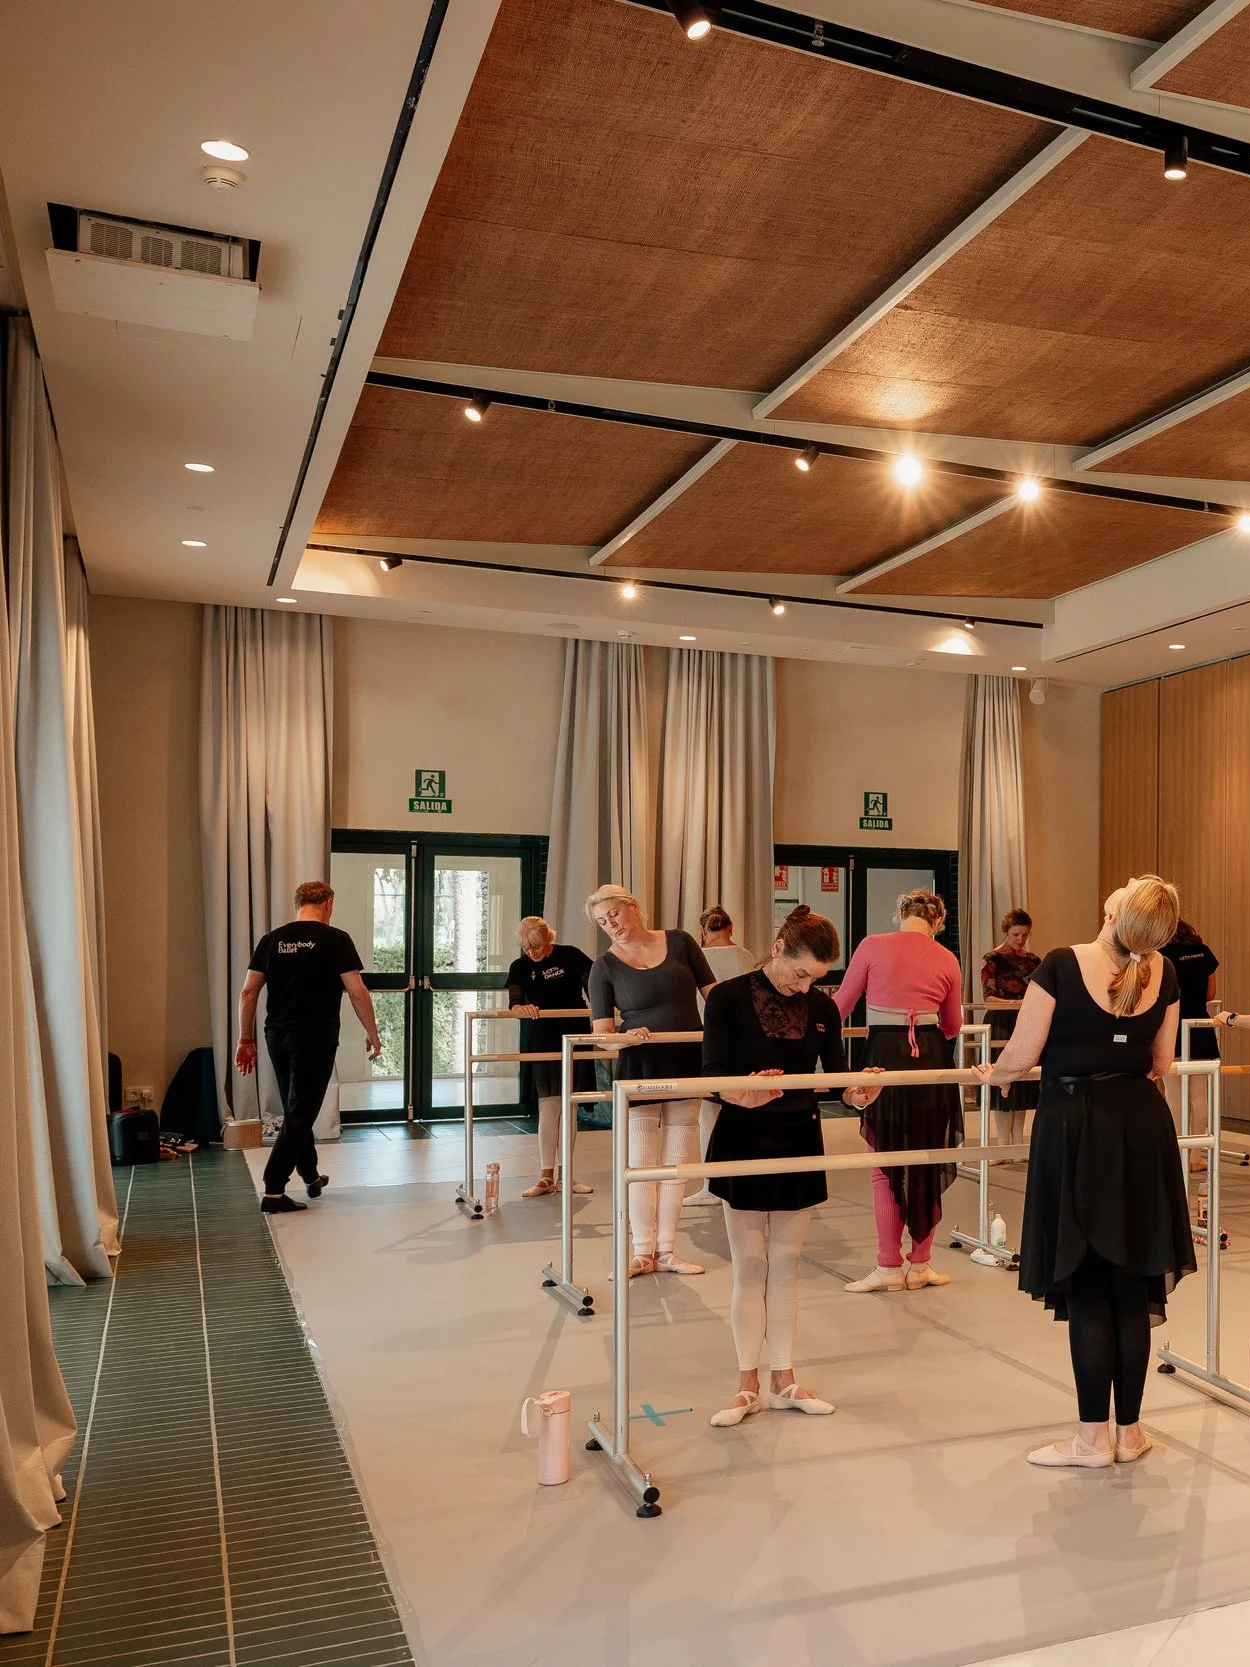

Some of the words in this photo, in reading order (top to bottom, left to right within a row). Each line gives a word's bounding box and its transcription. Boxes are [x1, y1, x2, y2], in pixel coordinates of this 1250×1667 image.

[413, 800, 447, 811] SALIDA
[862, 819, 889, 828] SALIDA
[278, 940, 316, 950] Everybody
